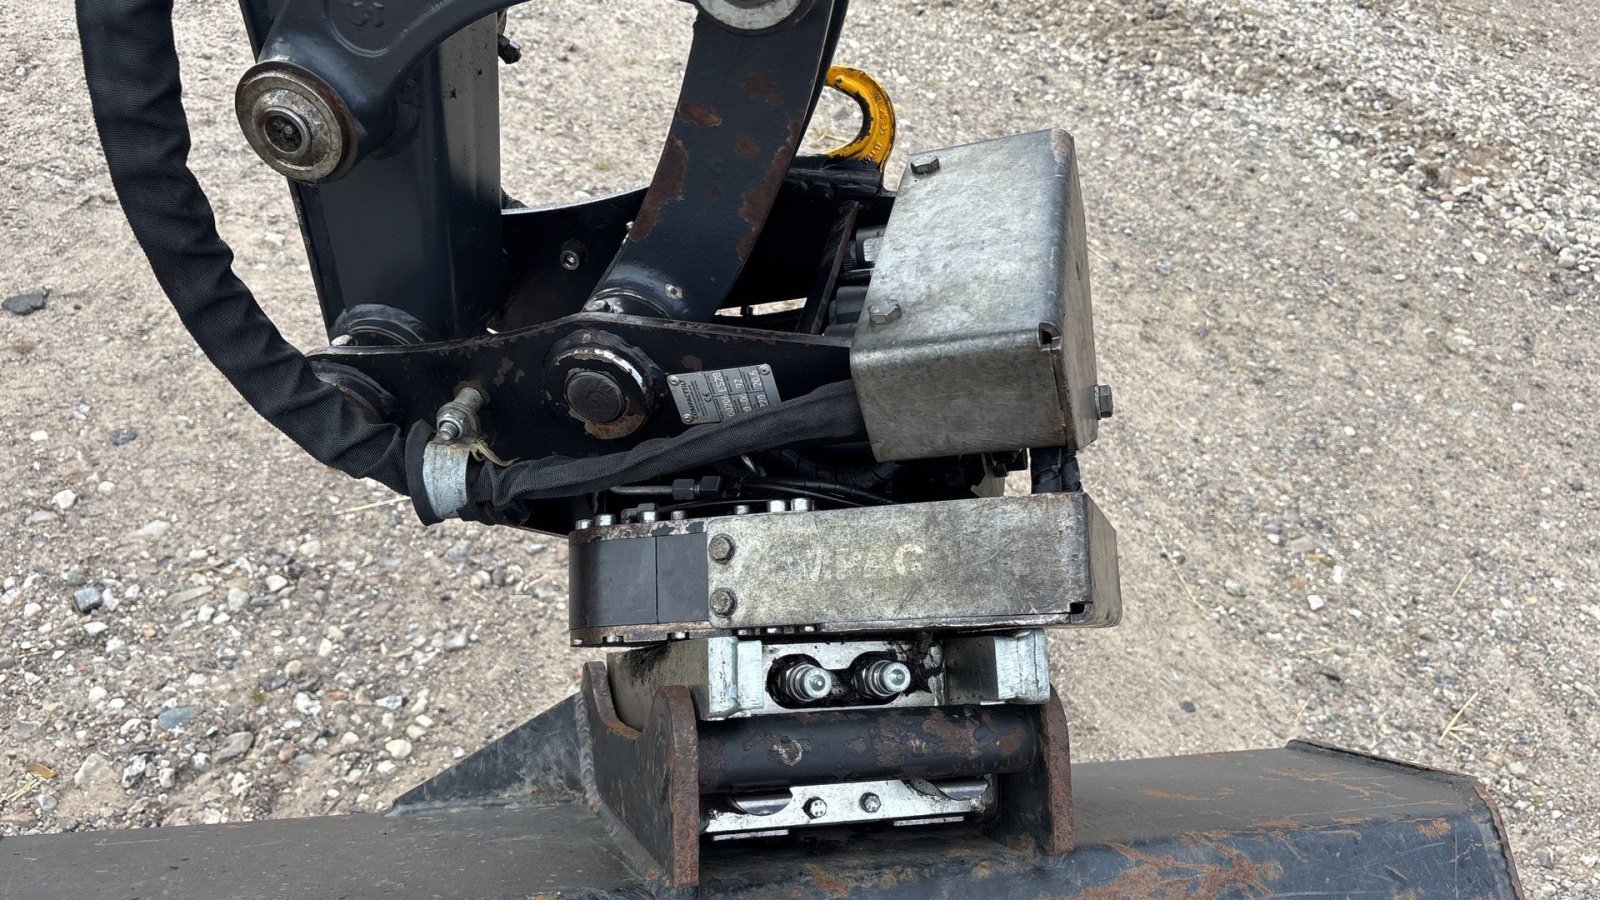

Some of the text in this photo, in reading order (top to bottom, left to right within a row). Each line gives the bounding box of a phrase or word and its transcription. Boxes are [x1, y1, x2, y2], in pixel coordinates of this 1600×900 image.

[712, 372, 727, 392] ES28
[734, 378, 744, 389] 92
[749, 370, 762, 387] 20.6
[680, 380, 698, 420] COMPACTTILT
[702, 392, 712, 402] CE
